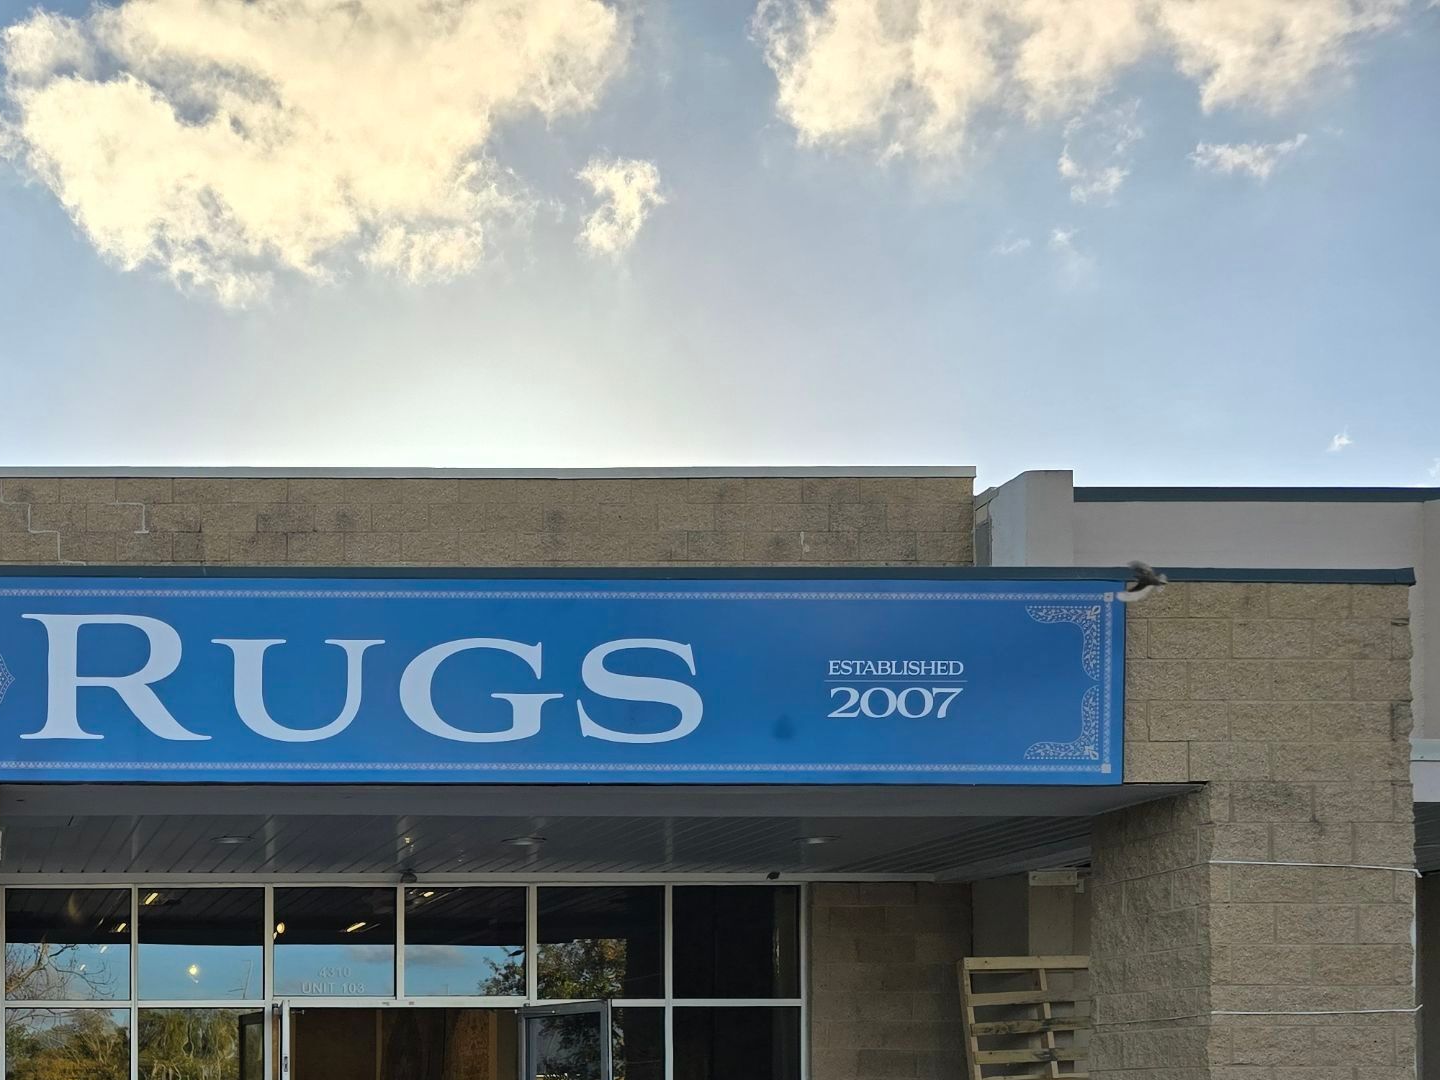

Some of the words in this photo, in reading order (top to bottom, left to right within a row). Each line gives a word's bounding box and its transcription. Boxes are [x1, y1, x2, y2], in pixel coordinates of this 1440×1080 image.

[827, 659, 965, 677] ESTABLISHED
[19, 613, 704, 743] RUGS
[826, 686, 964, 719] 2007
[318, 967, 353, 979] 4310
[301, 982, 336, 994] UNIT
[341, 983, 366, 994] 103
